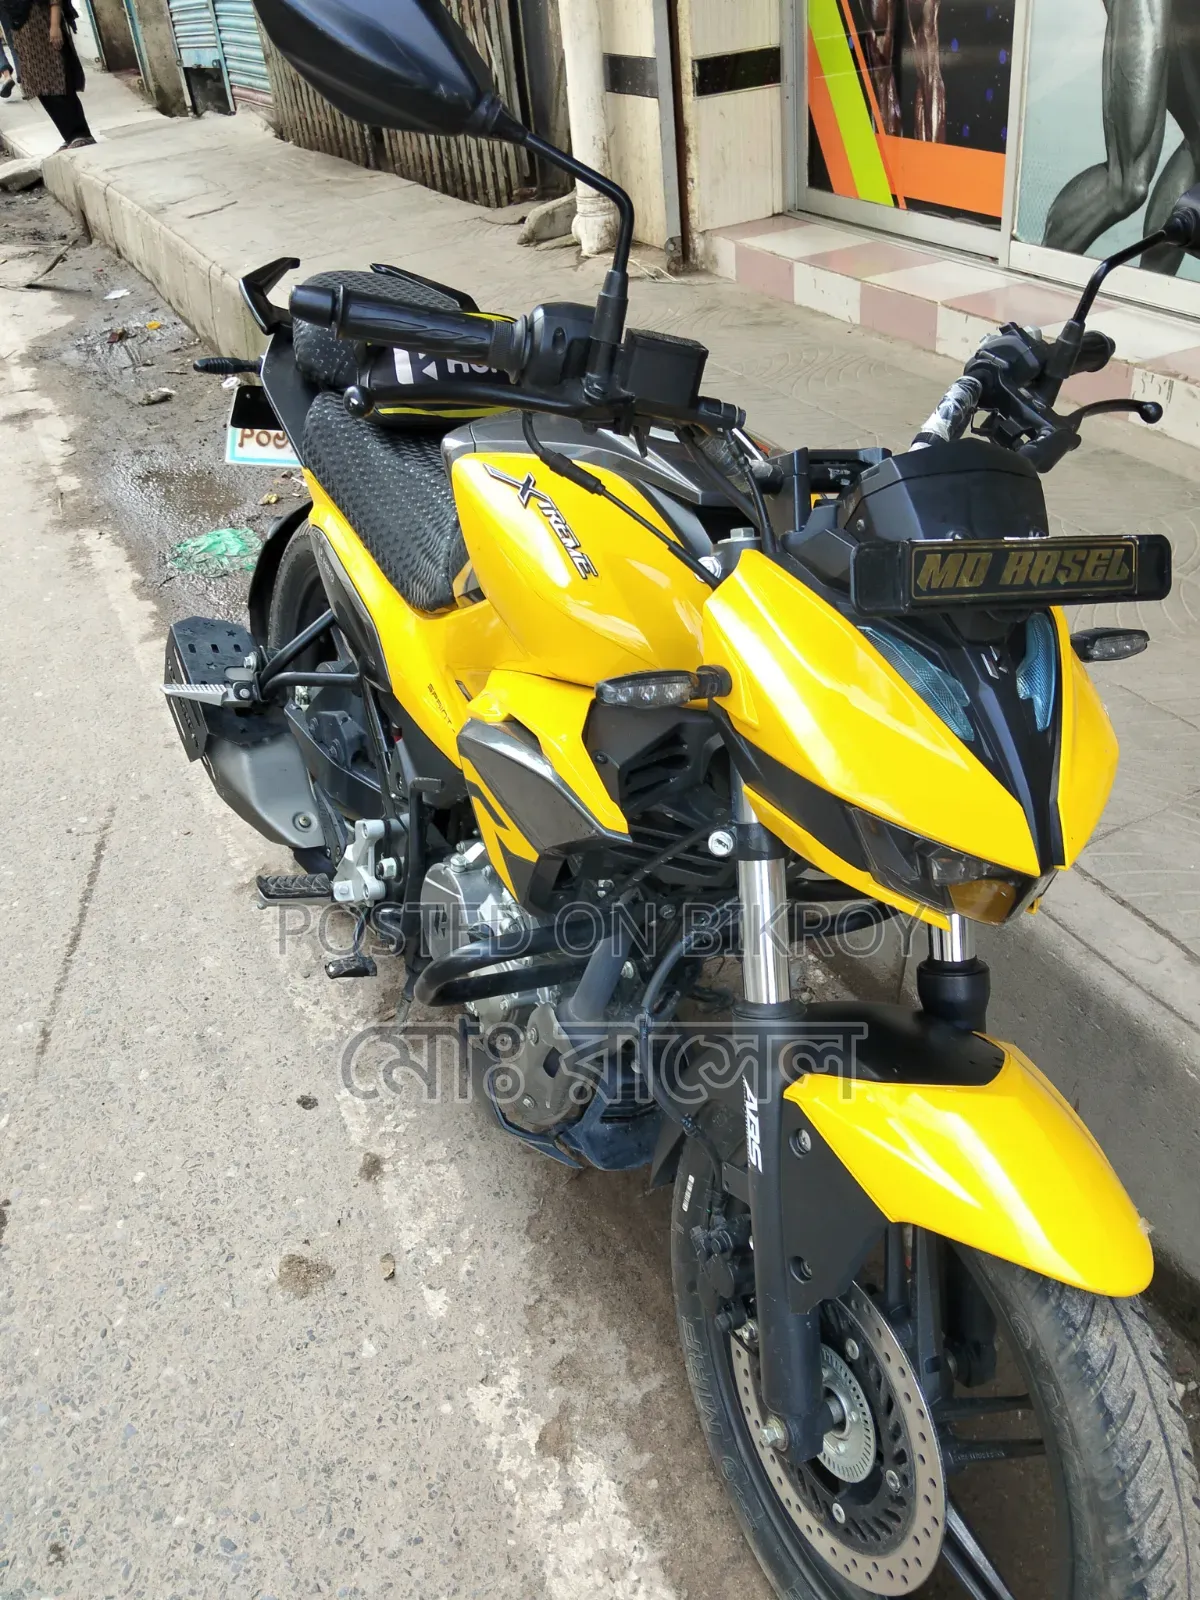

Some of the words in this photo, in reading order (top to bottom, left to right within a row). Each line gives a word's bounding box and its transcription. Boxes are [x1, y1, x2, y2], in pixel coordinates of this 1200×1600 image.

[483, 463, 598, 580] XTREME
[917, 553, 992, 591] MD
[999, 549, 1130, 587] RASEL
[742, 1074, 763, 1173] ABS
[682, 1315, 724, 1436] MRF
